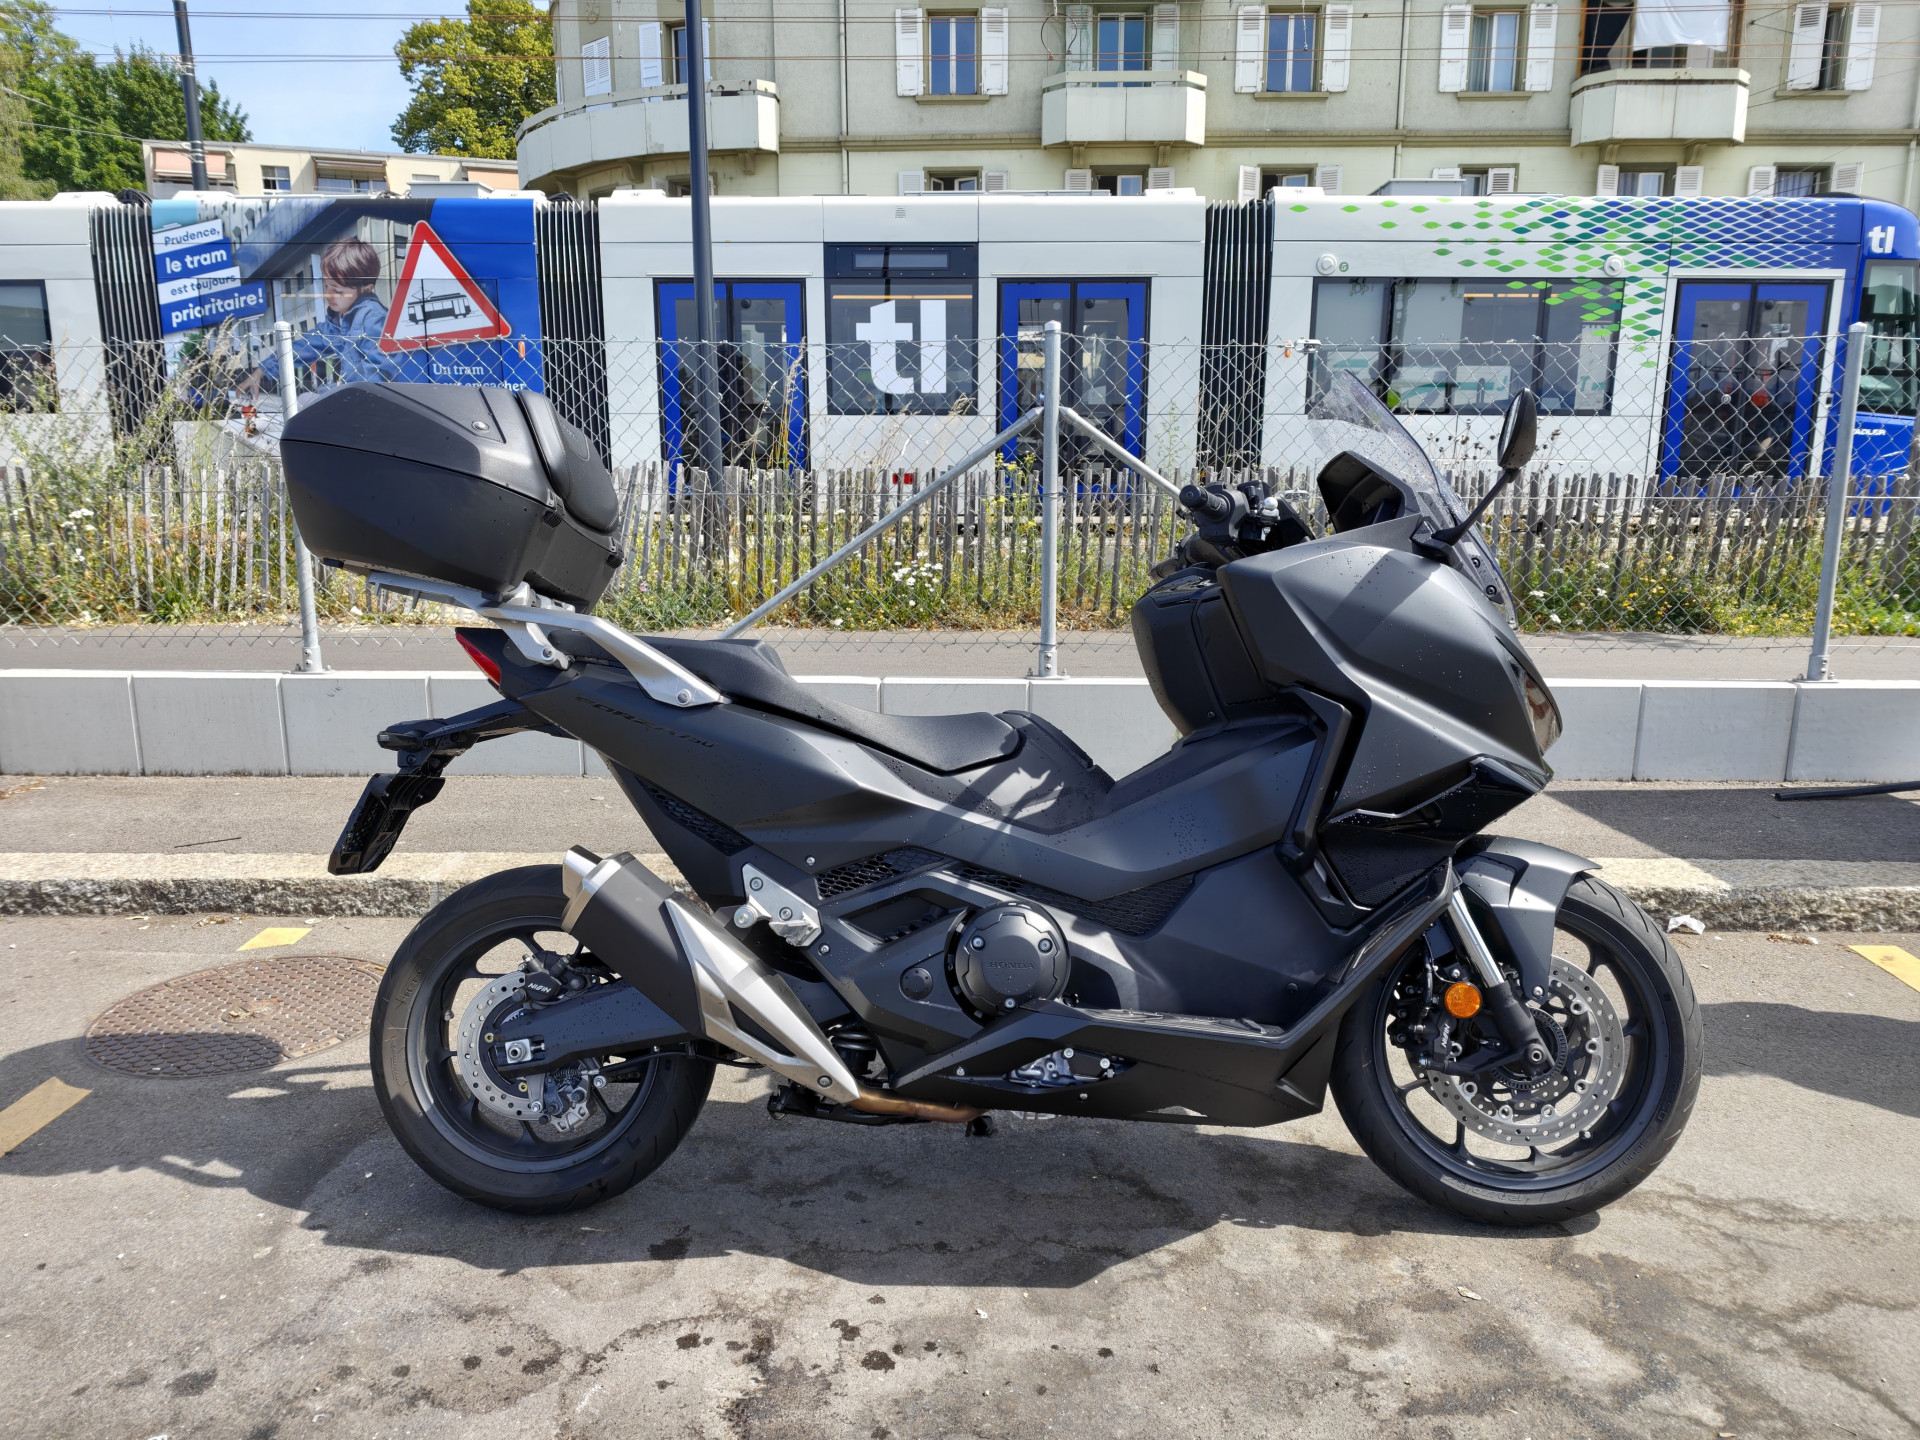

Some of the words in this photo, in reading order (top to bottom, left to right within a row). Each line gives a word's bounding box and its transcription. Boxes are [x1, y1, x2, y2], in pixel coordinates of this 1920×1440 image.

[164, 227, 220, 246] Prudence,
[1868, 225, 1896, 254] tl
[165, 257, 183, 274] le
[184, 249, 228, 269] tram
[170, 284, 188, 296] est
[191, 274, 237, 291] toujours
[171, 287, 264, 328] prioritaire!
[856, 299, 947, 395] tl
[433, 363, 452, 375] Un
[453, 365, 485, 376] tram
[987, 961, 1036, 970] HONDA
